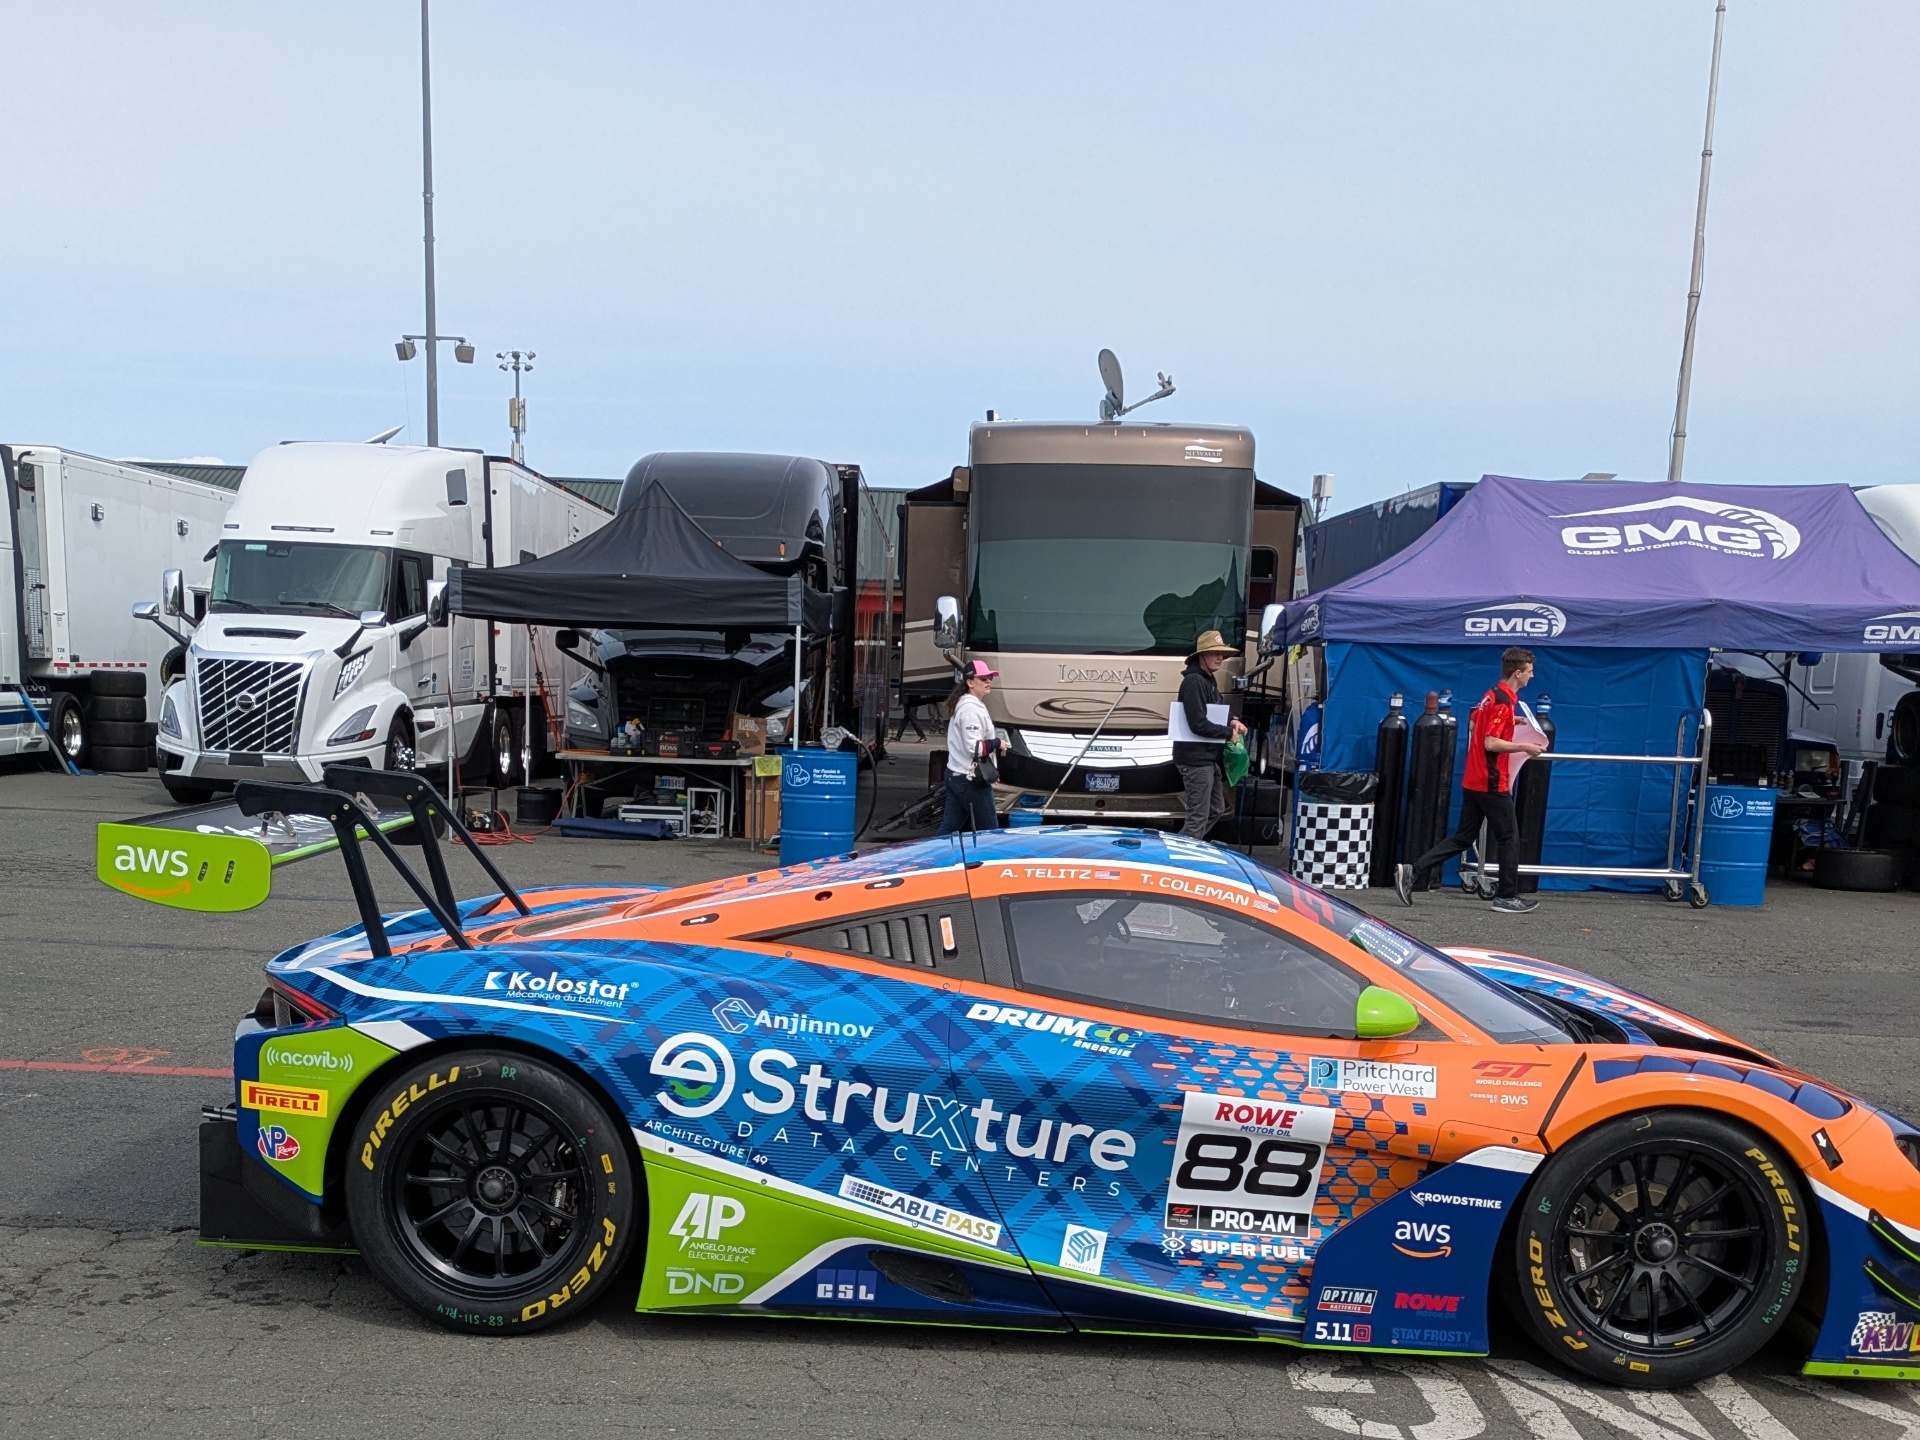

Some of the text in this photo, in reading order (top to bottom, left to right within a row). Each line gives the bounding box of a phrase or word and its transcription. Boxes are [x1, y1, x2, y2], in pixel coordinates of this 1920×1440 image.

[1561, 519, 1762, 550] GMG
[1624, 540, 1718, 553] MOTORSPORTS
[1723, 548, 1765, 558] GROUP
[1464, 617, 1549, 632] GMG
[114, 844, 189, 877] aws
[1000, 868, 1092, 880] A. TELITZ
[1140, 873, 1250, 907] T. COLEMAN
[508, 971, 630, 1001] Kolostat
[505, 990, 624, 1009] Mécanique du bâtiment
[753, 1009, 875, 1038] Anjinnov
[280, 1050, 338, 1069] acovib
[1343, 1060, 1435, 1084] Pritchard
[1475, 1078, 1502, 1086] WORLD
[1343, 1078, 1424, 1097] Power West
[248, 1085, 321, 1112] PIRELLI
[1500, 1094, 1529, 1105] aws
[361, 1065, 461, 1171] PIRELLI
[1214, 1101, 1299, 1130] ROWE
[1239, 1125, 1292, 1137] MOTOR OIL
[644, 1119, 768, 1166] ARCHITECTURE 49
[1175, 1132, 1322, 1198] 88
[1415, 1191, 1502, 1210] CROWDSTRIKE
[1745, 1147, 1801, 1253] PIRELLI
[881, 1191, 997, 1242] CABLEPASS
[1210, 1209, 1296, 1234] PRO-AM
[1394, 1219, 1451, 1244] aws
[689, 1241, 757, 1256] ANGELO PAONE
[1190, 1238, 1312, 1260] SUPER FUEL
[734, 1255, 750, 1264] INC
[665, 1271, 745, 1295] DND
[816, 1283, 875, 1301] CSL
[1322, 1289, 1374, 1305] OPTIMA
[1394, 1292, 1461, 1313] ROWE
[1314, 1321, 1352, 1342] 5.11
[1391, 1327, 1472, 1343] STAY FROSTY
